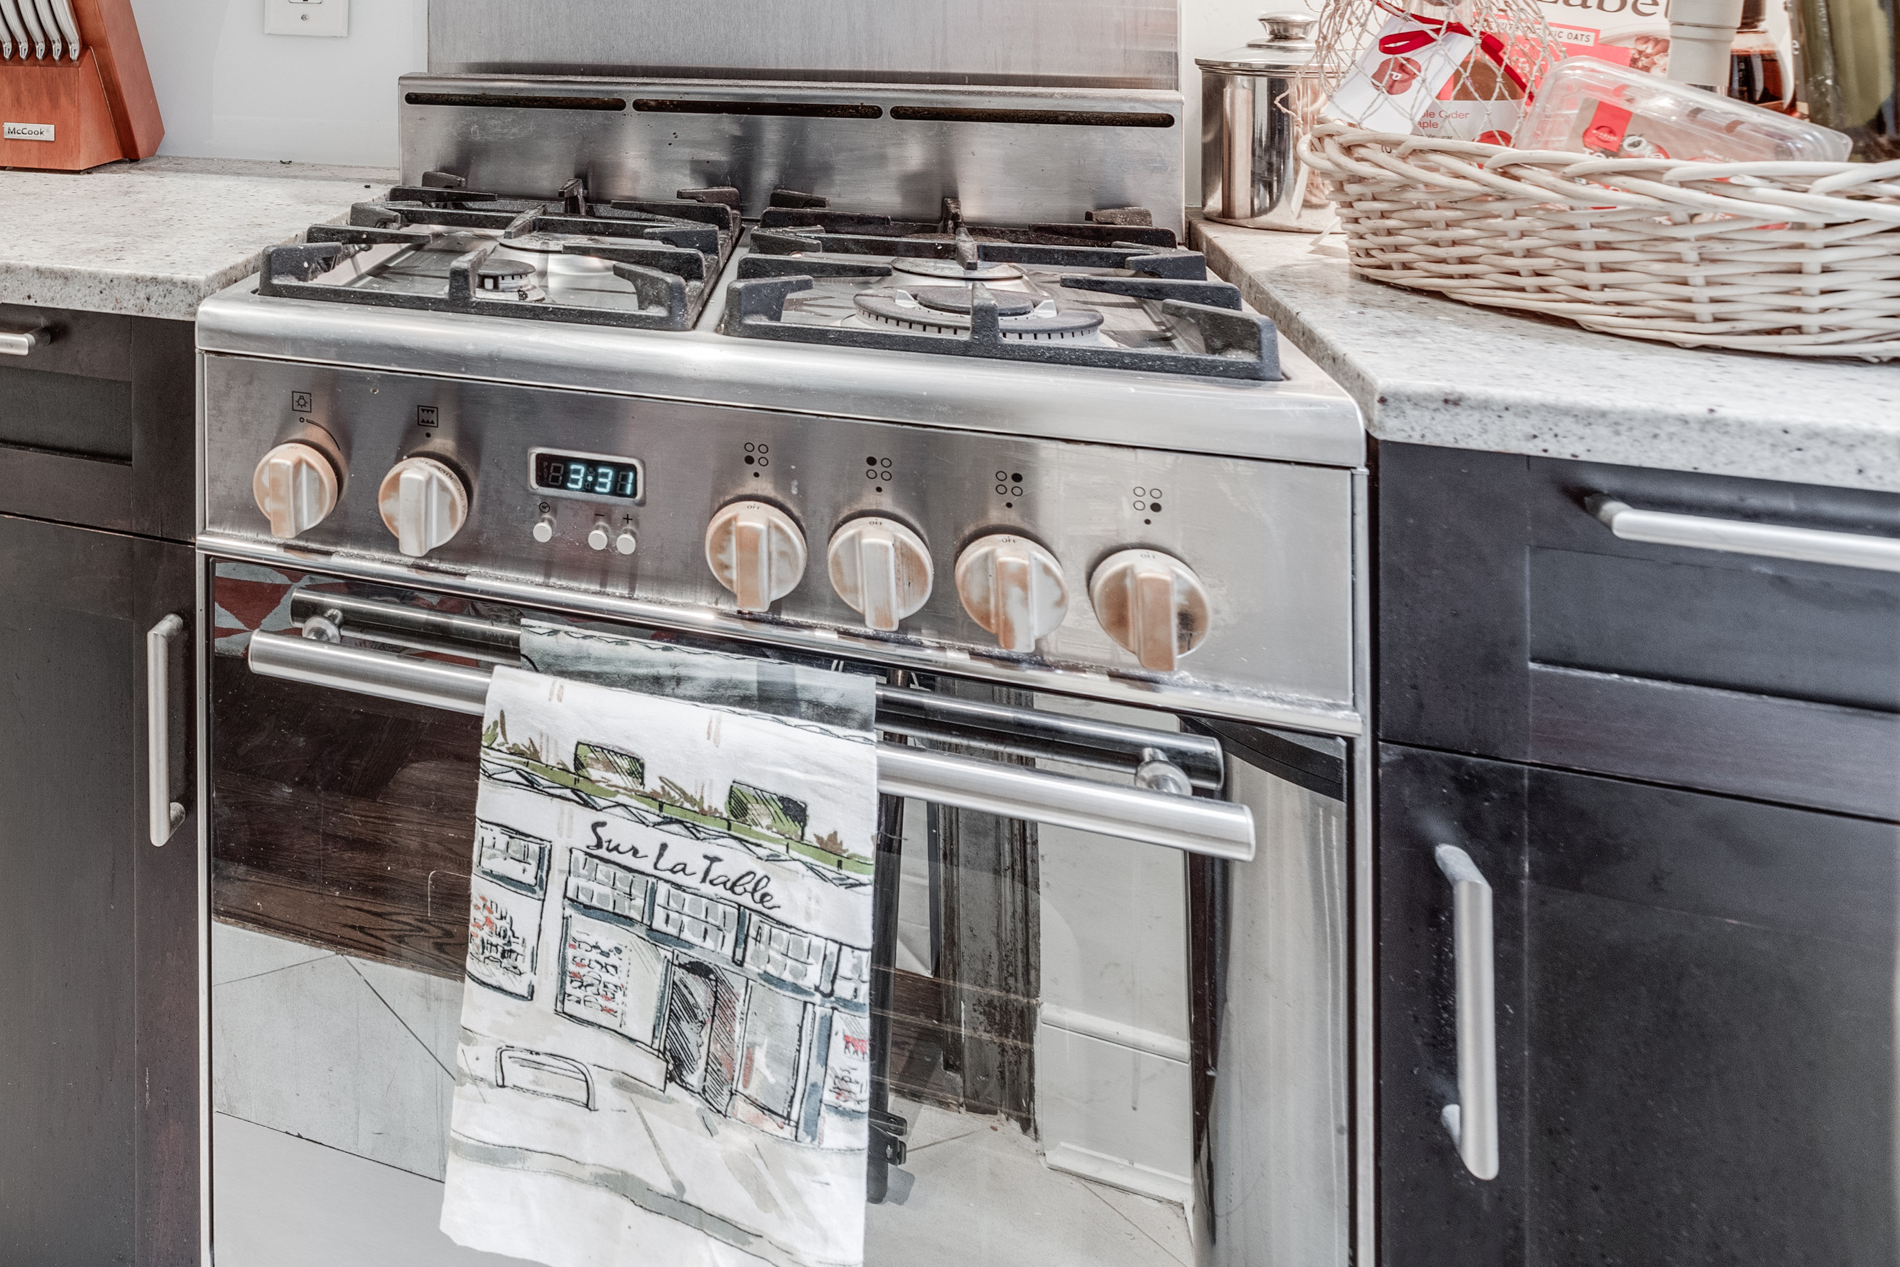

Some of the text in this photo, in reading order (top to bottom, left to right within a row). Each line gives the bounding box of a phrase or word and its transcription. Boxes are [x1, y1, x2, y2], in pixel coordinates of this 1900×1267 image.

[1567, 32, 1591, 43] OATS
[1418, 120, 1438, 129] aple
[7, 127, 45, 136] McCook
[586, 821, 781, 909] Sur La Table
